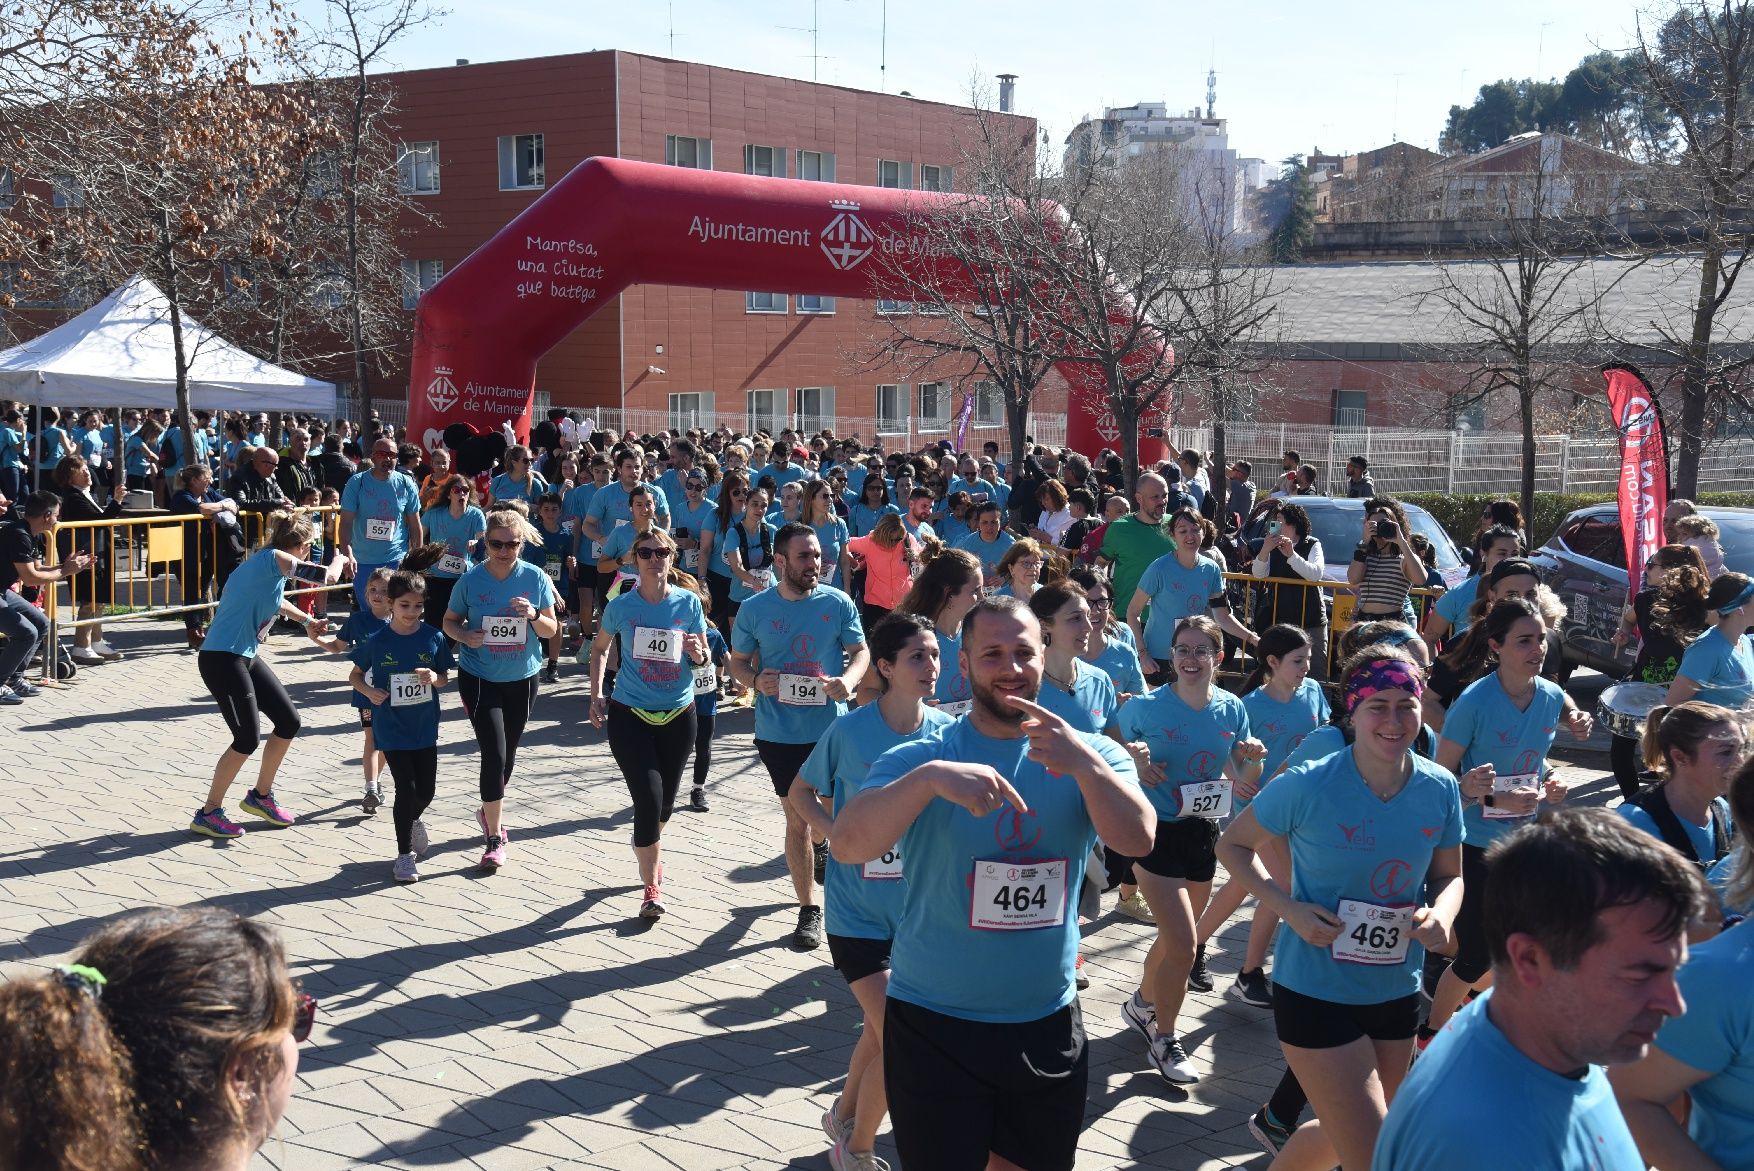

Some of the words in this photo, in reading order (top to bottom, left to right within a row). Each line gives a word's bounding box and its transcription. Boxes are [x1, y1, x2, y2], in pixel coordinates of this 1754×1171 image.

[687, 215, 812, 247] Ajuntament
[881, 232, 906, 255] de
[526, 235, 598, 258] Manresa,
[517, 259, 547, 273] una
[553, 259, 605, 279] ciutat
[516, 281, 543, 298] que
[551, 281, 596, 303] batega
[463, 398, 480, 412] de
[371, 525, 390, 535] 557
[444, 560, 461, 570] 545
[490, 625, 518, 638] 694
[647, 639, 668, 653] 40
[396, 684, 427, 698] 1021
[789, 683, 817, 698] 194
[1192, 794, 1222, 813] 527
[993, 883, 1047, 912] 464
[1350, 922, 1400, 949] 463
